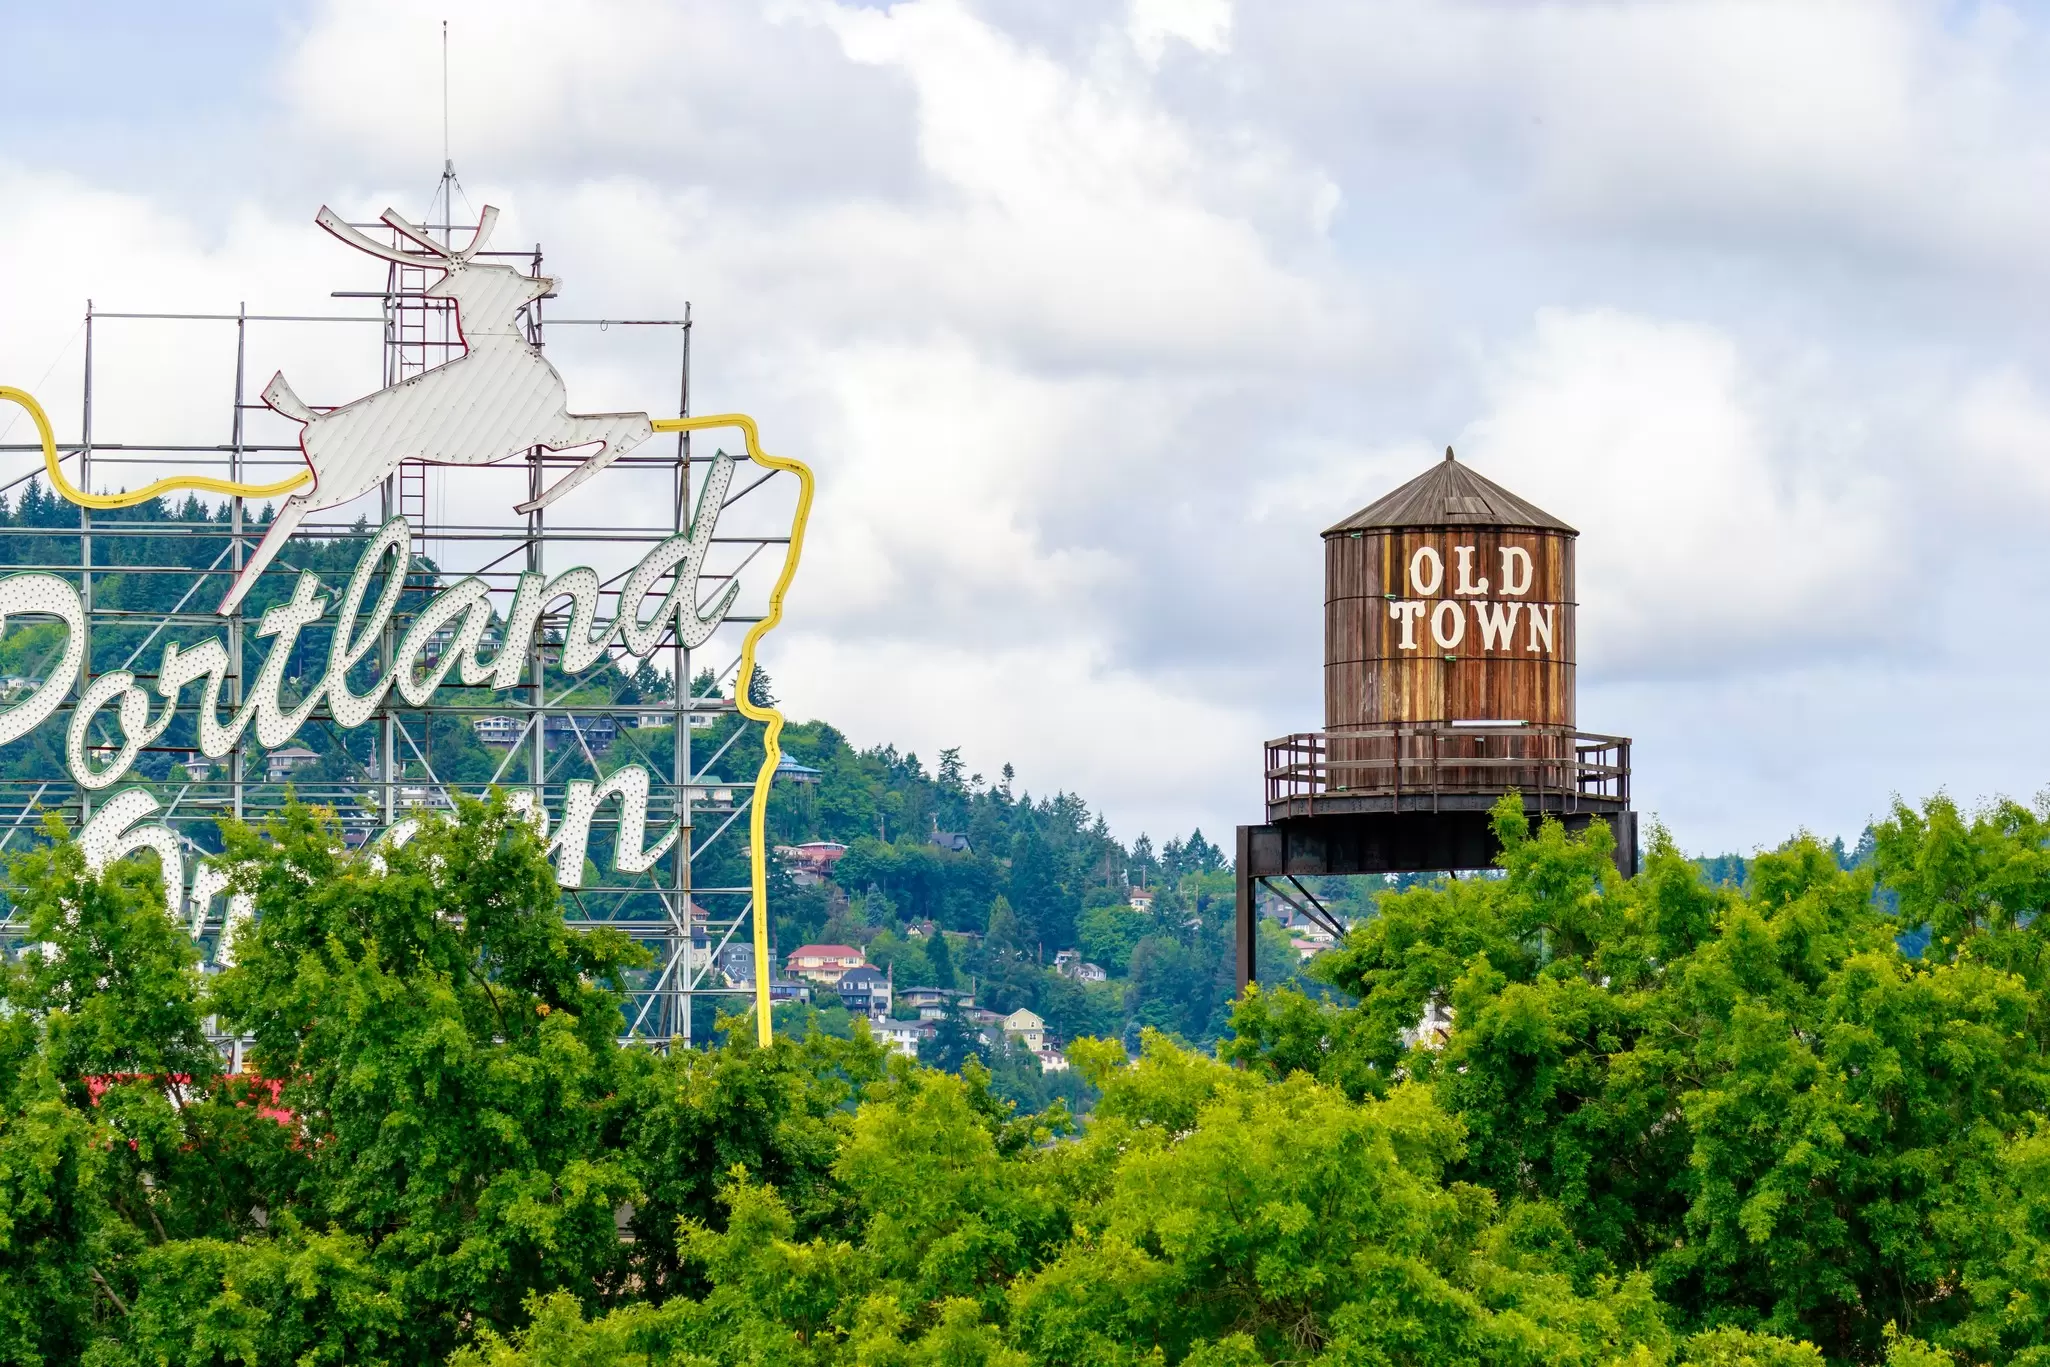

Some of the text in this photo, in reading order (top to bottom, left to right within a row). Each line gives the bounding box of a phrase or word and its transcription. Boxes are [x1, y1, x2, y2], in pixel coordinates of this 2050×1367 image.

[1409, 546, 1534, 596] OLD
[1389, 600, 1556, 653] TOWN
[40, 763, 680, 972] Orn
